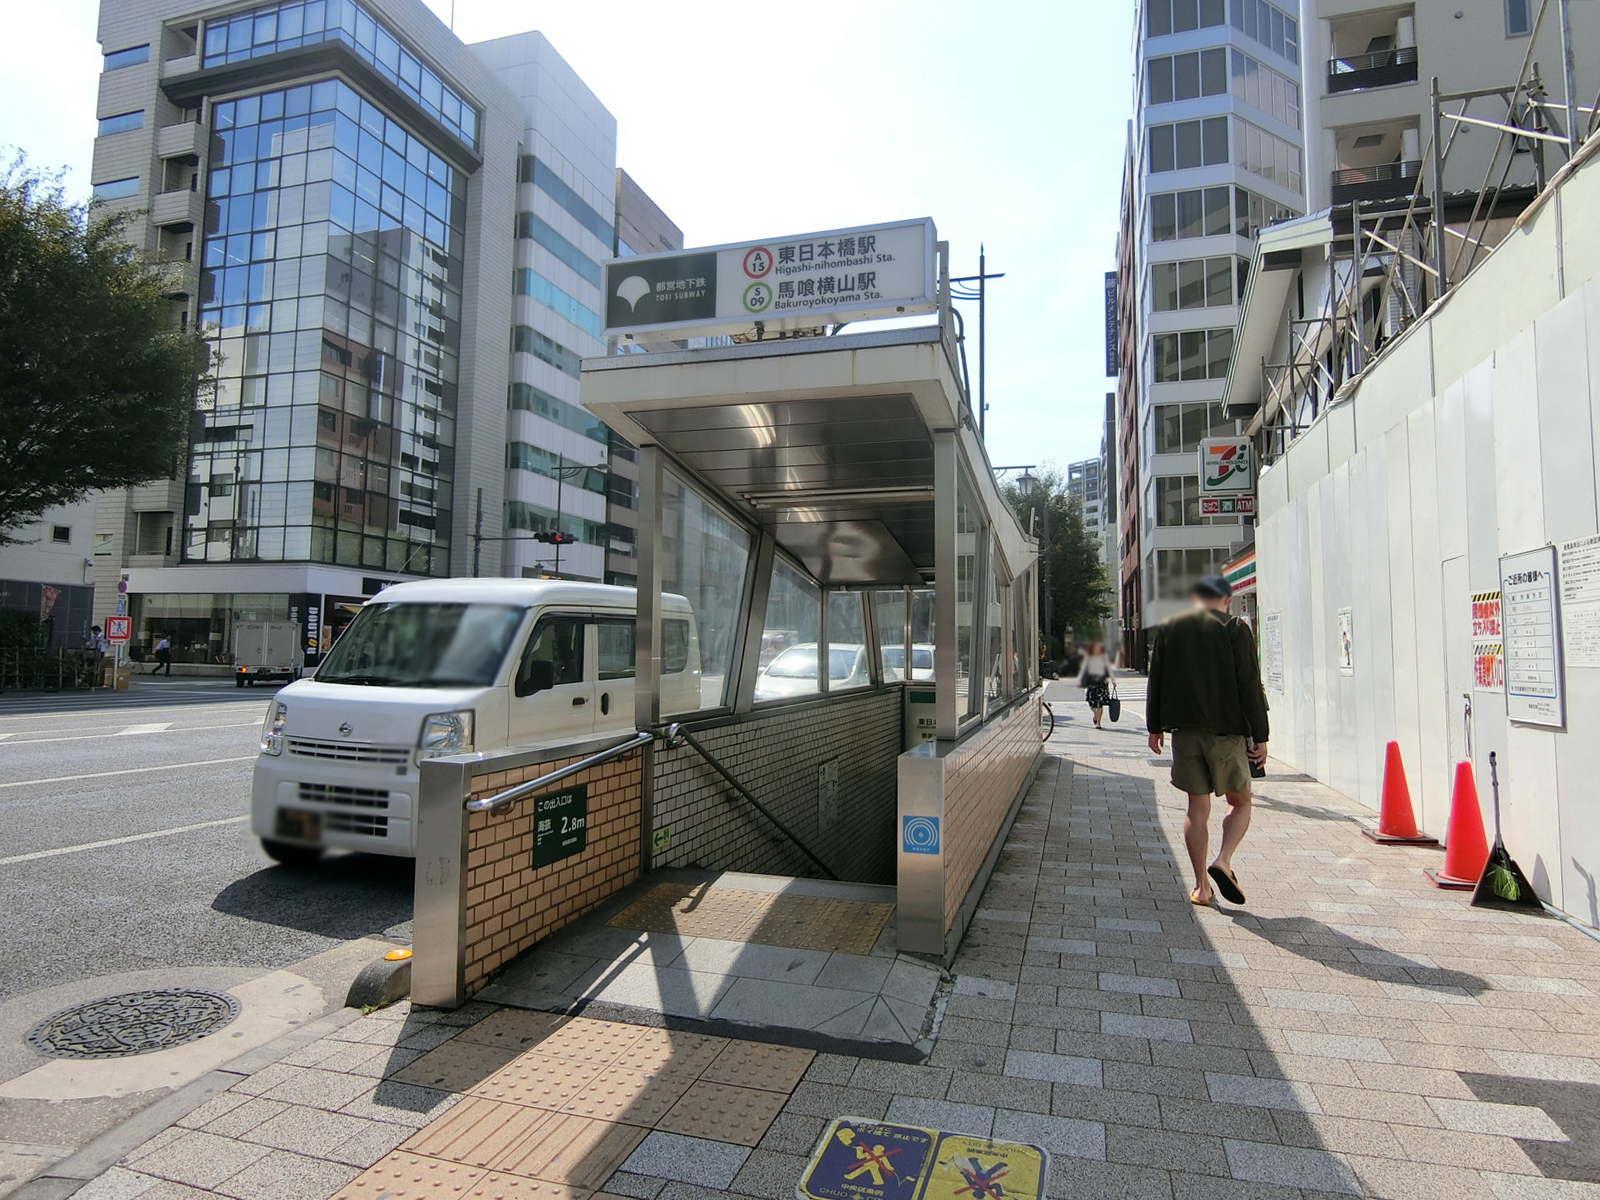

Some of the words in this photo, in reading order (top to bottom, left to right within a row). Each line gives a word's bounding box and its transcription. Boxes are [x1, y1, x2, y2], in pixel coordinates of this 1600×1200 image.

[753, 252, 762, 262] A
[777, 234, 877, 265] 東日本橋駅
[751, 261, 765, 273] 15
[774, 254, 874, 276] Higashi-nihombashi
[876, 254, 896, 264] Sta.
[655, 277, 707, 293] 都営地下鉄
[754, 286, 761, 297] S
[777, 270, 877, 300] 馬喰横山駅
[655, 291, 673, 302] TOEI
[674, 288, 707, 301] SUBWAY
[750, 295, 766, 308] 09
[774, 293, 861, 310] Bakuroyokoyama
[863, 290, 884, 301] Sta.
[1203, 502, 1218, 511] たばこ
[1237, 500, 1252, 510] ATM
[307, 607, 318, 654] DOUTOR
[538, 795, 572, 812] この出入口は
[561, 816, 585, 834] 2.8m
[818, 1187, 848, 1198] CHUO
